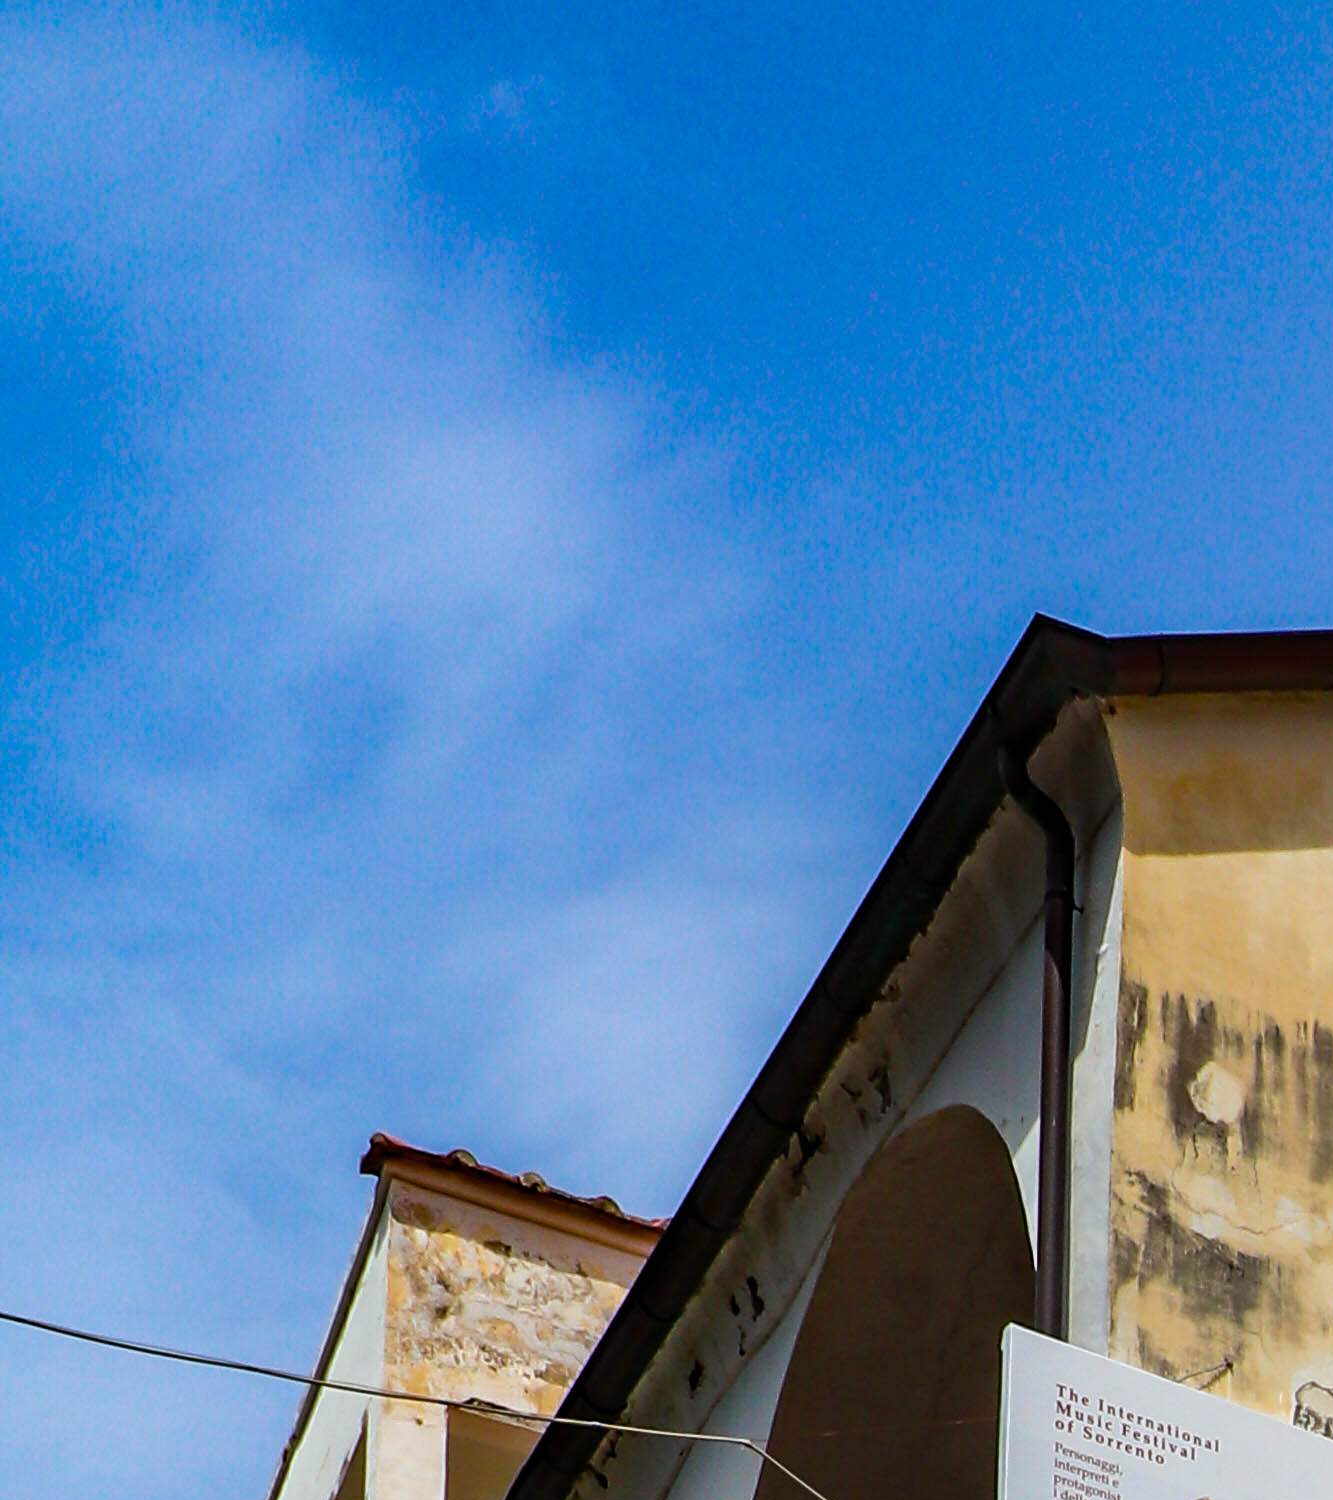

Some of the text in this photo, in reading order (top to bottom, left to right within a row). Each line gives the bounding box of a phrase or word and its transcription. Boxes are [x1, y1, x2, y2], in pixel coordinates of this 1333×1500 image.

[1056, 1383, 1219, 1453] The International
[1056, 1400, 1195, 1461] Music Festival
[1055, 1420, 1165, 1465] of Sorrento
[1055, 1441, 1123, 1476] Personaggi,
[1053, 1487, 1057, 1498] i
[1054, 1457, 1119, 1489] interpreti e
